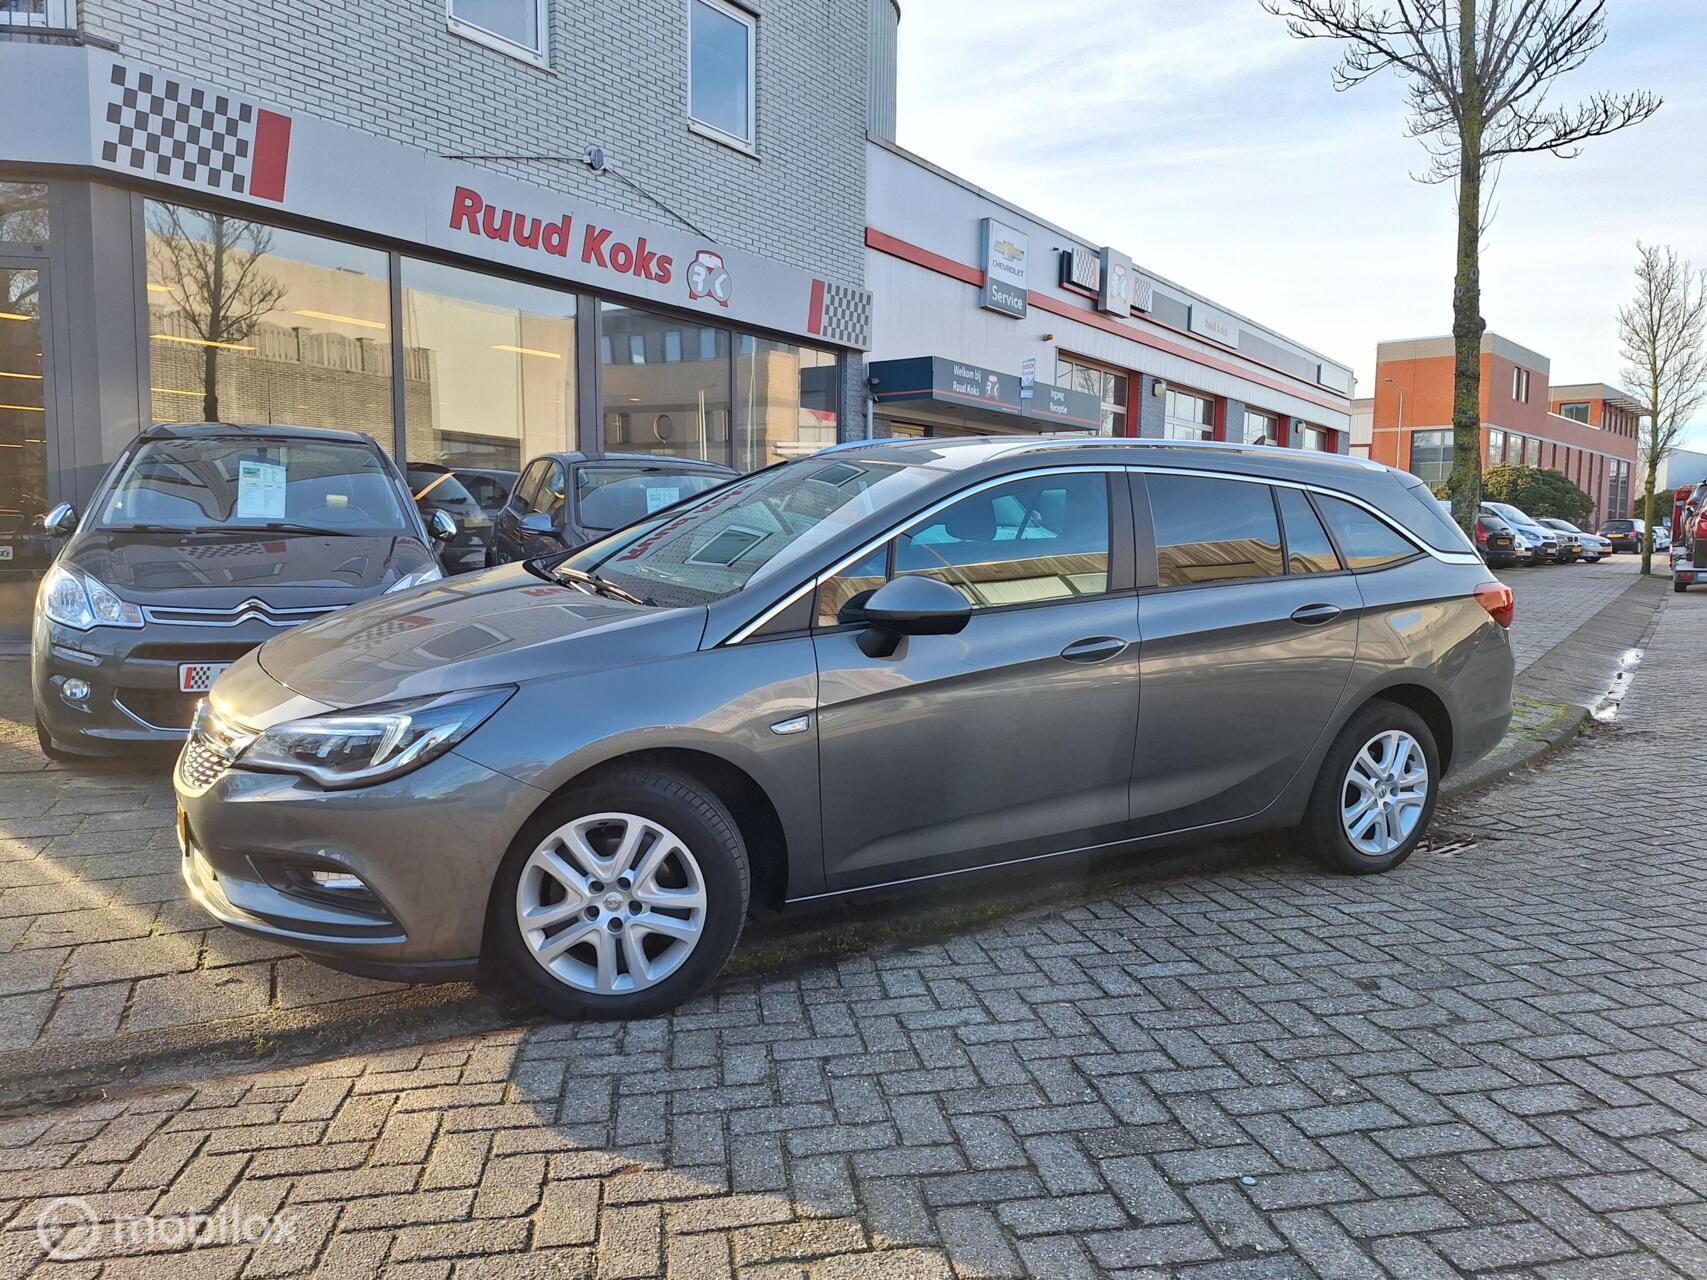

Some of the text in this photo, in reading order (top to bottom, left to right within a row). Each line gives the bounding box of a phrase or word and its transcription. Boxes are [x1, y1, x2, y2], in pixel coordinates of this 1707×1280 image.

[449, 185, 673, 284] Ruud Koks
[992, 260, 1025, 278] CHEVROLET
[991, 285, 1023, 310] Service
[953, 364, 975, 379] Welkom
[952, 381, 980, 396] Ruud Koks
